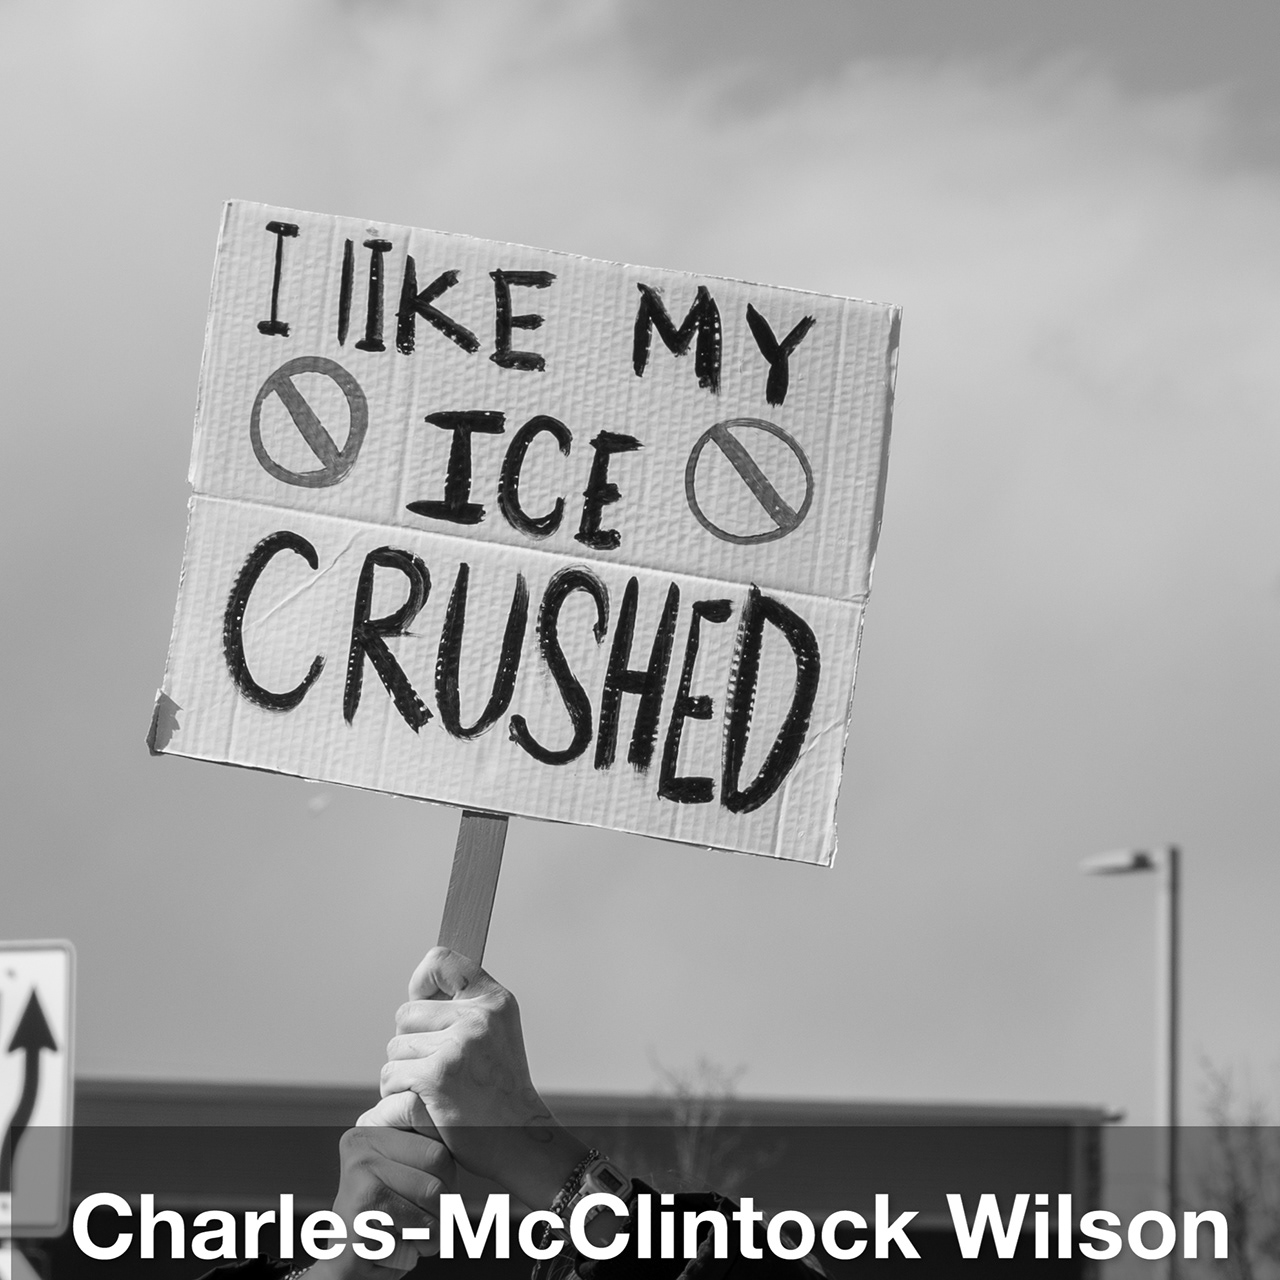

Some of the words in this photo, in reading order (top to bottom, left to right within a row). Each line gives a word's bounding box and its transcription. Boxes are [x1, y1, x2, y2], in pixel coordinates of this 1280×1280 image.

[257, 221, 300, 337] I
[632, 282, 817, 406] MY
[405, 410, 644, 550] ICE
[223, 530, 820, 814] CRUSHED
